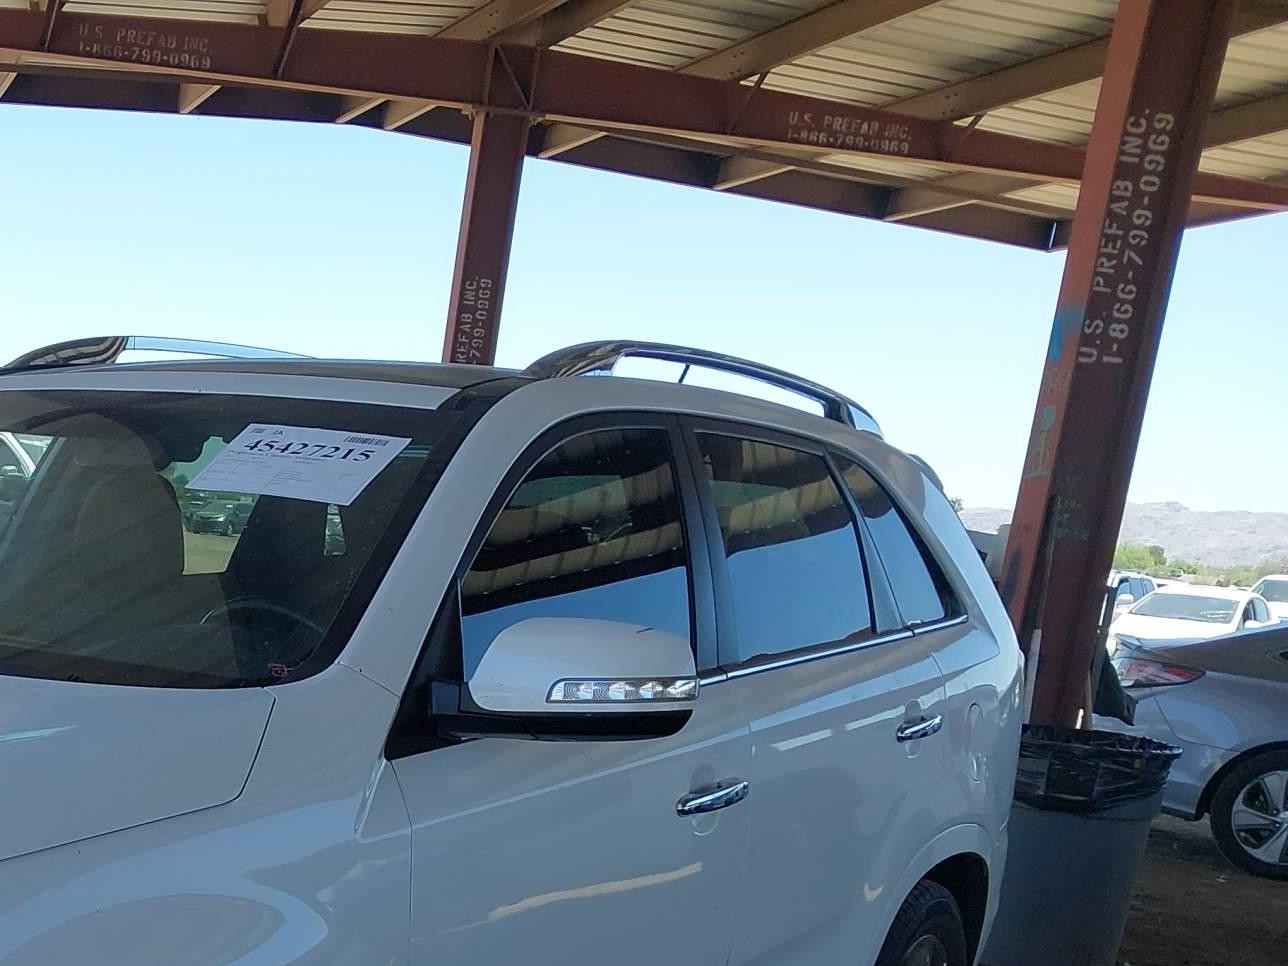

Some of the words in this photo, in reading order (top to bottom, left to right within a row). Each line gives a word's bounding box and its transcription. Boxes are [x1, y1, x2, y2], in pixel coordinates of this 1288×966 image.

[116, 28, 177, 49] PREFAB
[823, 115, 880, 136] PREFAB
[885, 123, 912, 141] INC.
[1093, 179, 1133, 293] PREFAB
[1120, 109, 1150, 163] INC.
[1102, 112, 1175, 364] 1-866-799-0969
[455, 313, 473, 362] REFAB
[464, 276, 478, 305] INC.
[469, 279, 492, 365] -799-0969
[244, 439, 376, 462] 45427215
